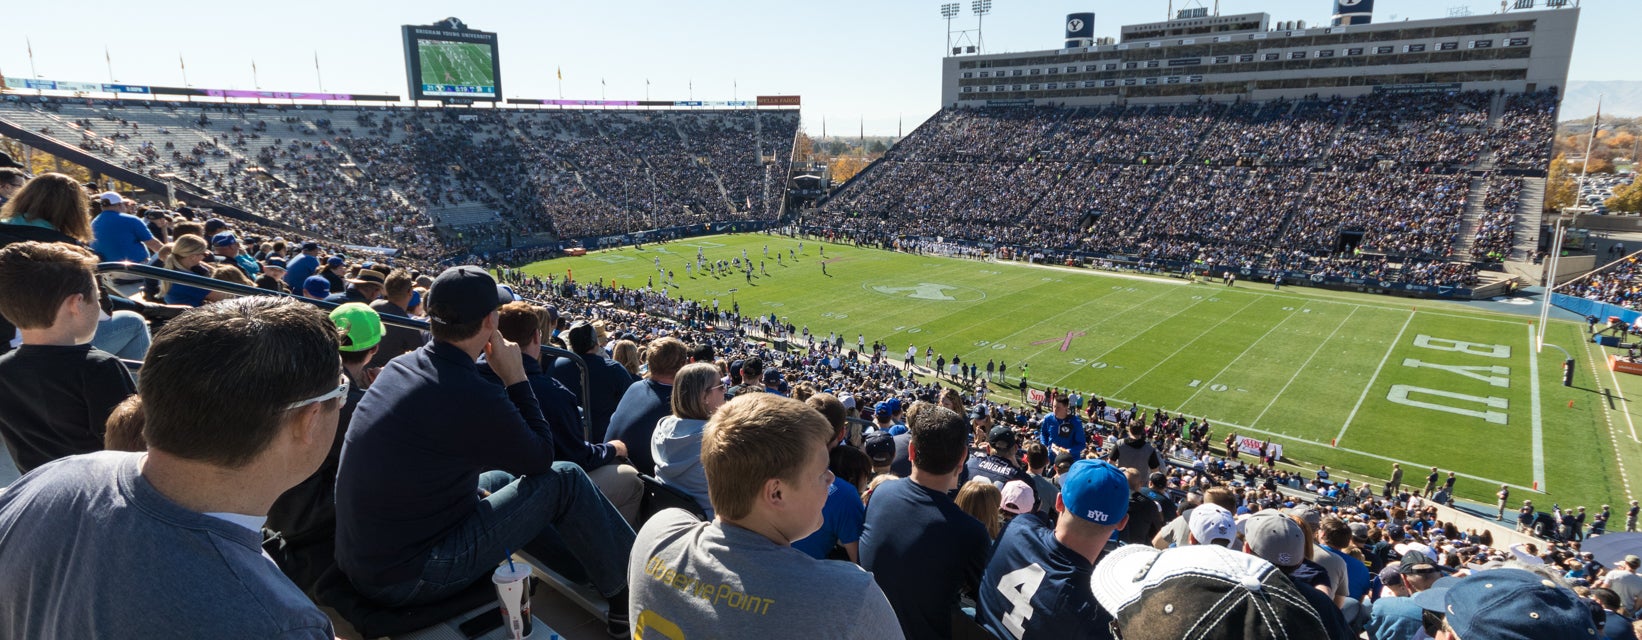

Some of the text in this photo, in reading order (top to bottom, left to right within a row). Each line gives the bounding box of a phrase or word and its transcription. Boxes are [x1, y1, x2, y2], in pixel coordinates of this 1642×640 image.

[415, 28, 441, 36] BRIGHAM
[1070, 357, 1108, 370] 20
[1188, 379, 1229, 392] 10
[1386, 333, 1512, 425] BYU
[979, 460, 1012, 476] COUGARS
[1087, 509, 1109, 522] BYU
[997, 562, 1046, 640] 4
